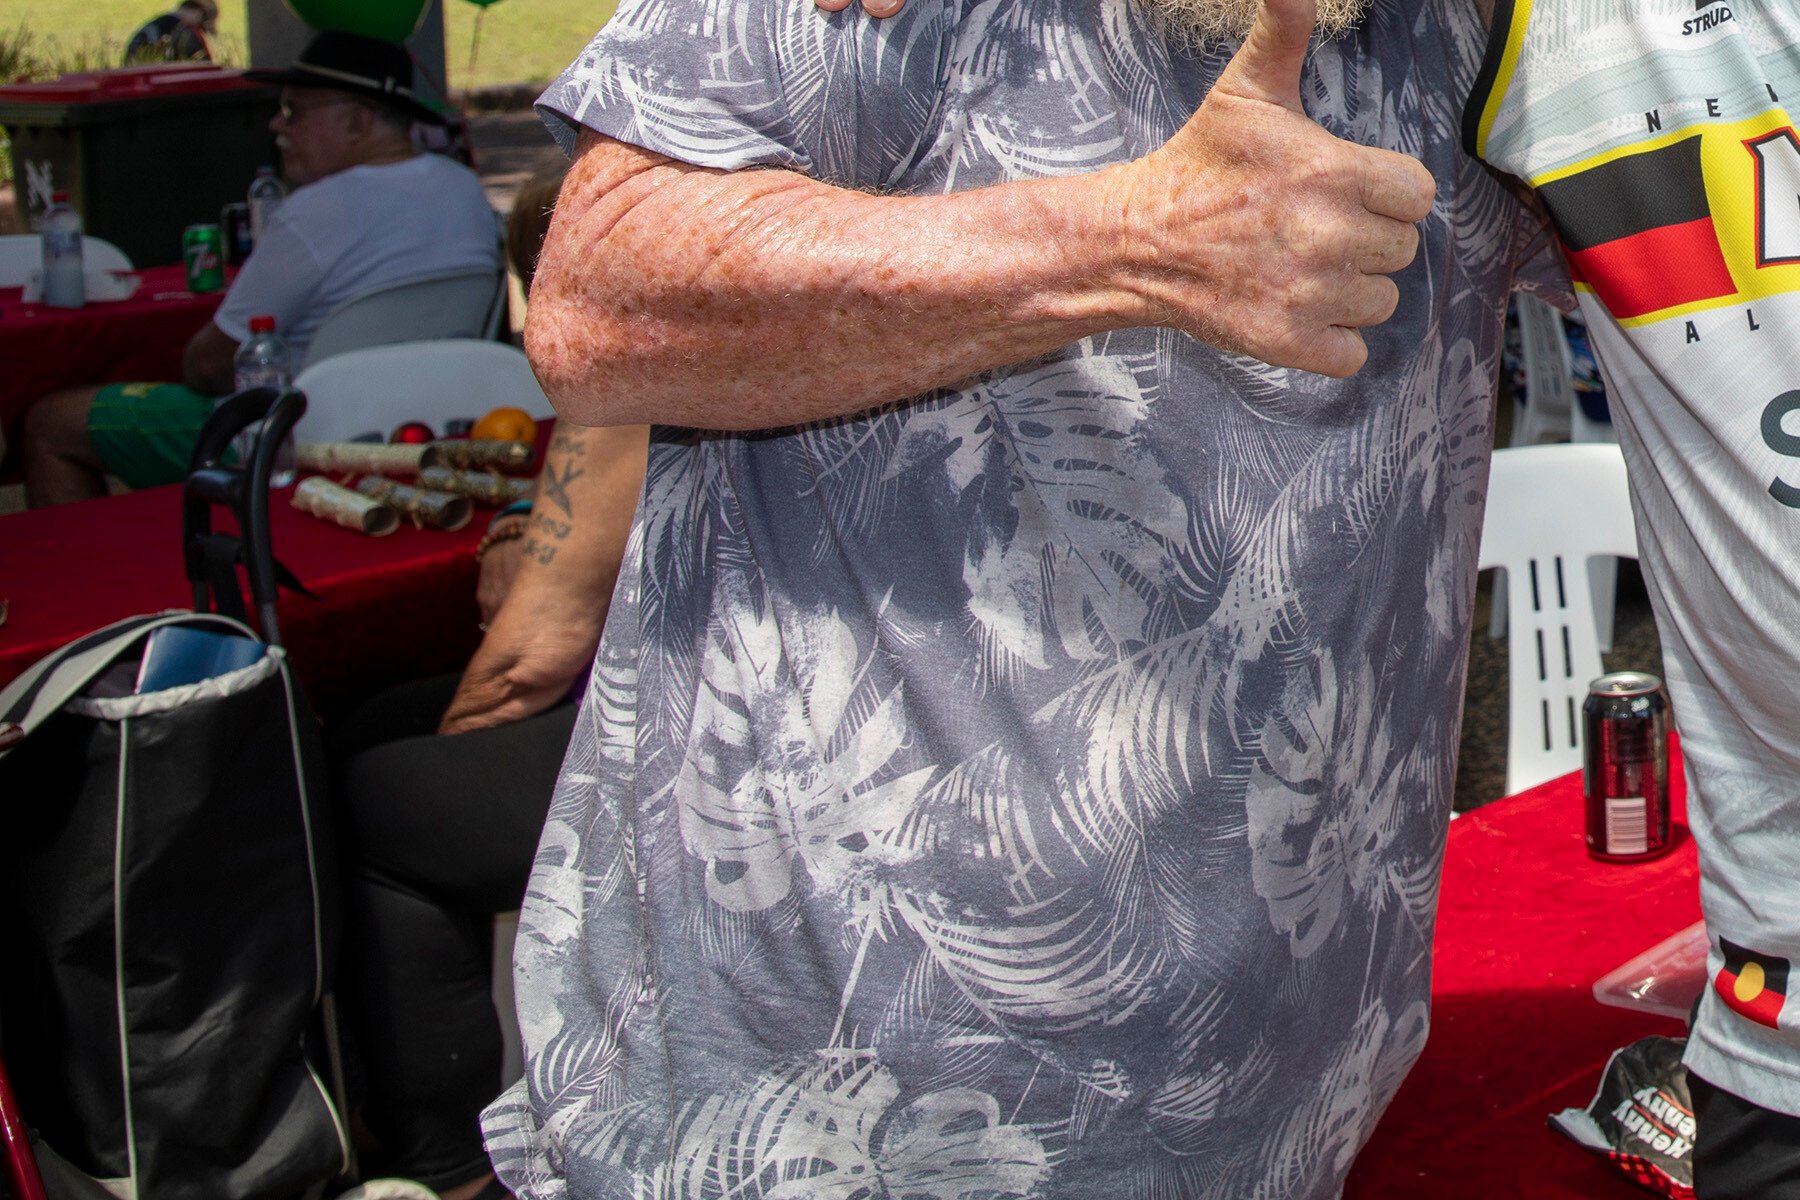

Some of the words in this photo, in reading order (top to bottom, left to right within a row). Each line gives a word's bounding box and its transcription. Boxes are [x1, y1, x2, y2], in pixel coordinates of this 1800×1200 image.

[1681, 6, 1736, 36] STRUD
[1611, 1099, 1693, 1160] Henny
[1633, 1085, 1697, 1142] enny
